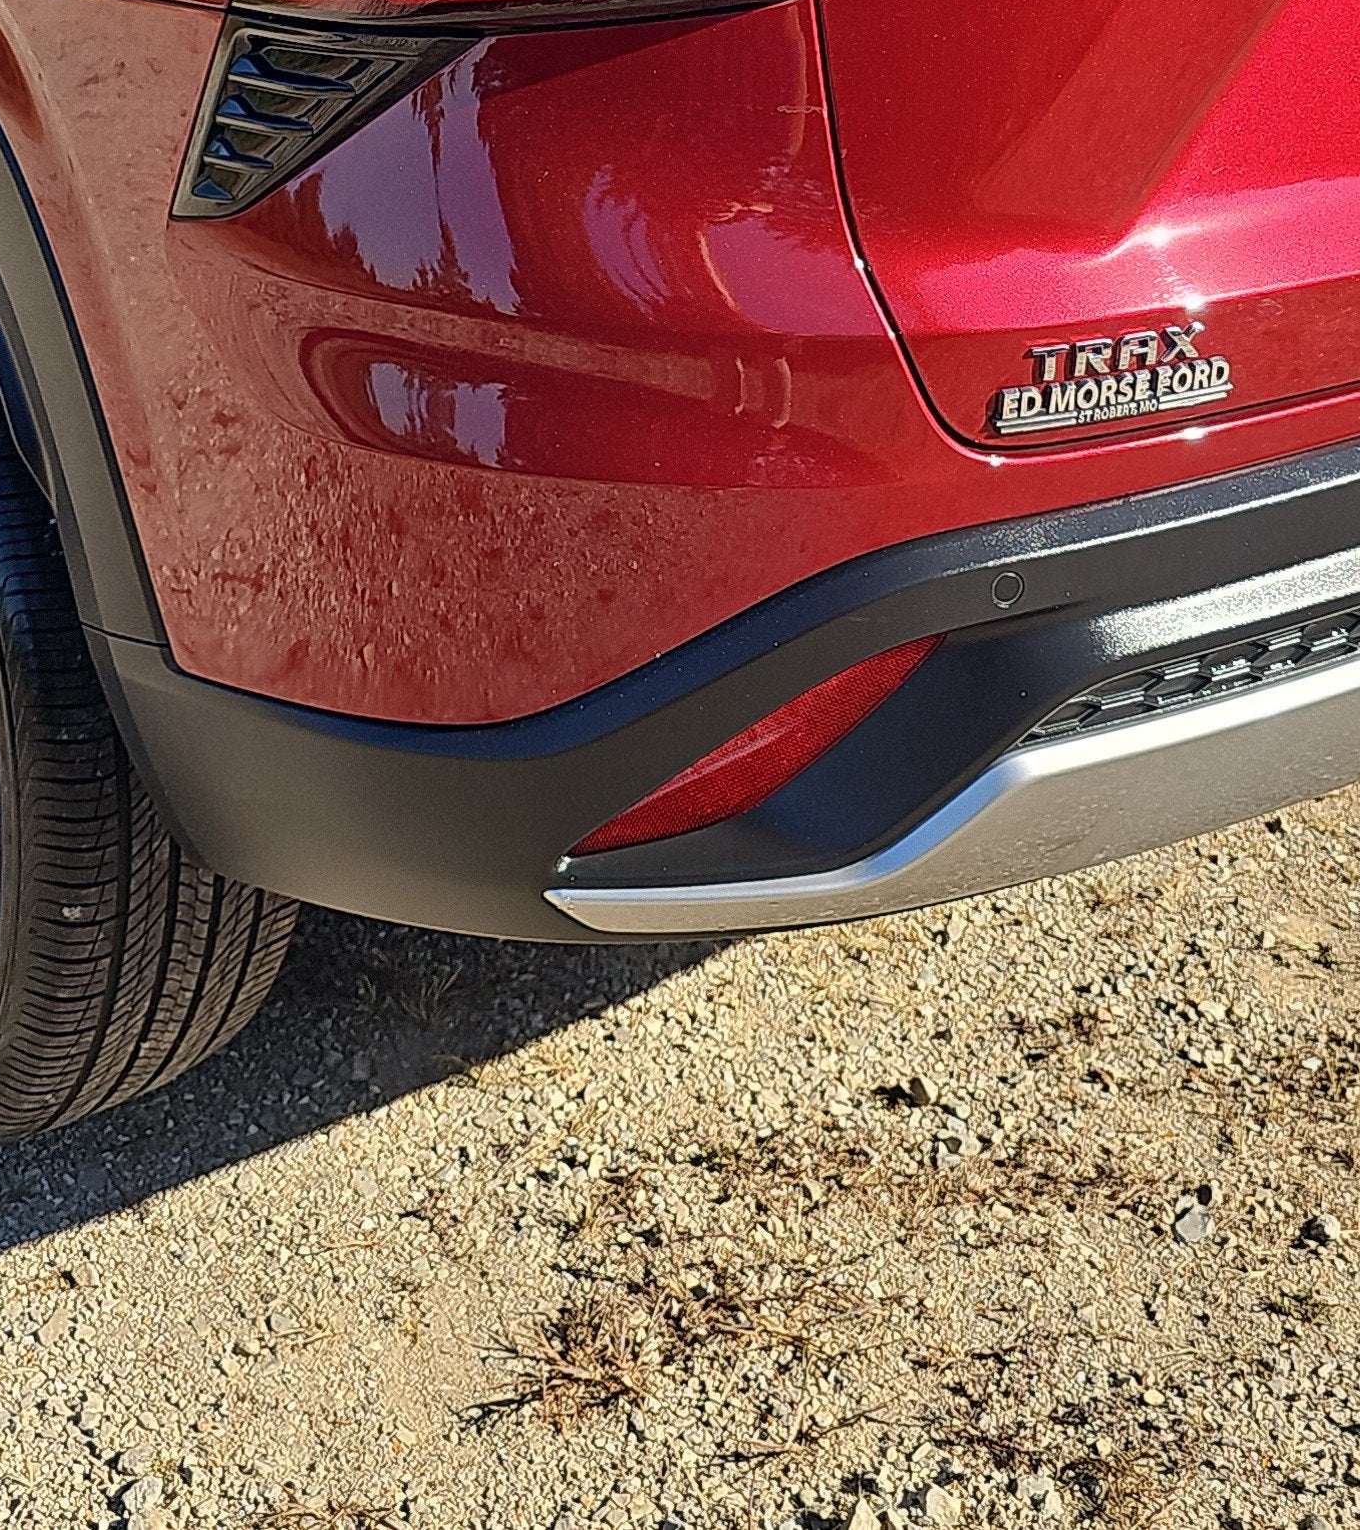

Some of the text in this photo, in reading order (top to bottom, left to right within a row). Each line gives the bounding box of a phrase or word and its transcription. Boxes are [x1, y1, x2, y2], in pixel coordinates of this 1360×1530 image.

[1026, 321, 1205, 382] TRAX
[999, 355, 1230, 419] ED MORSE FORD
